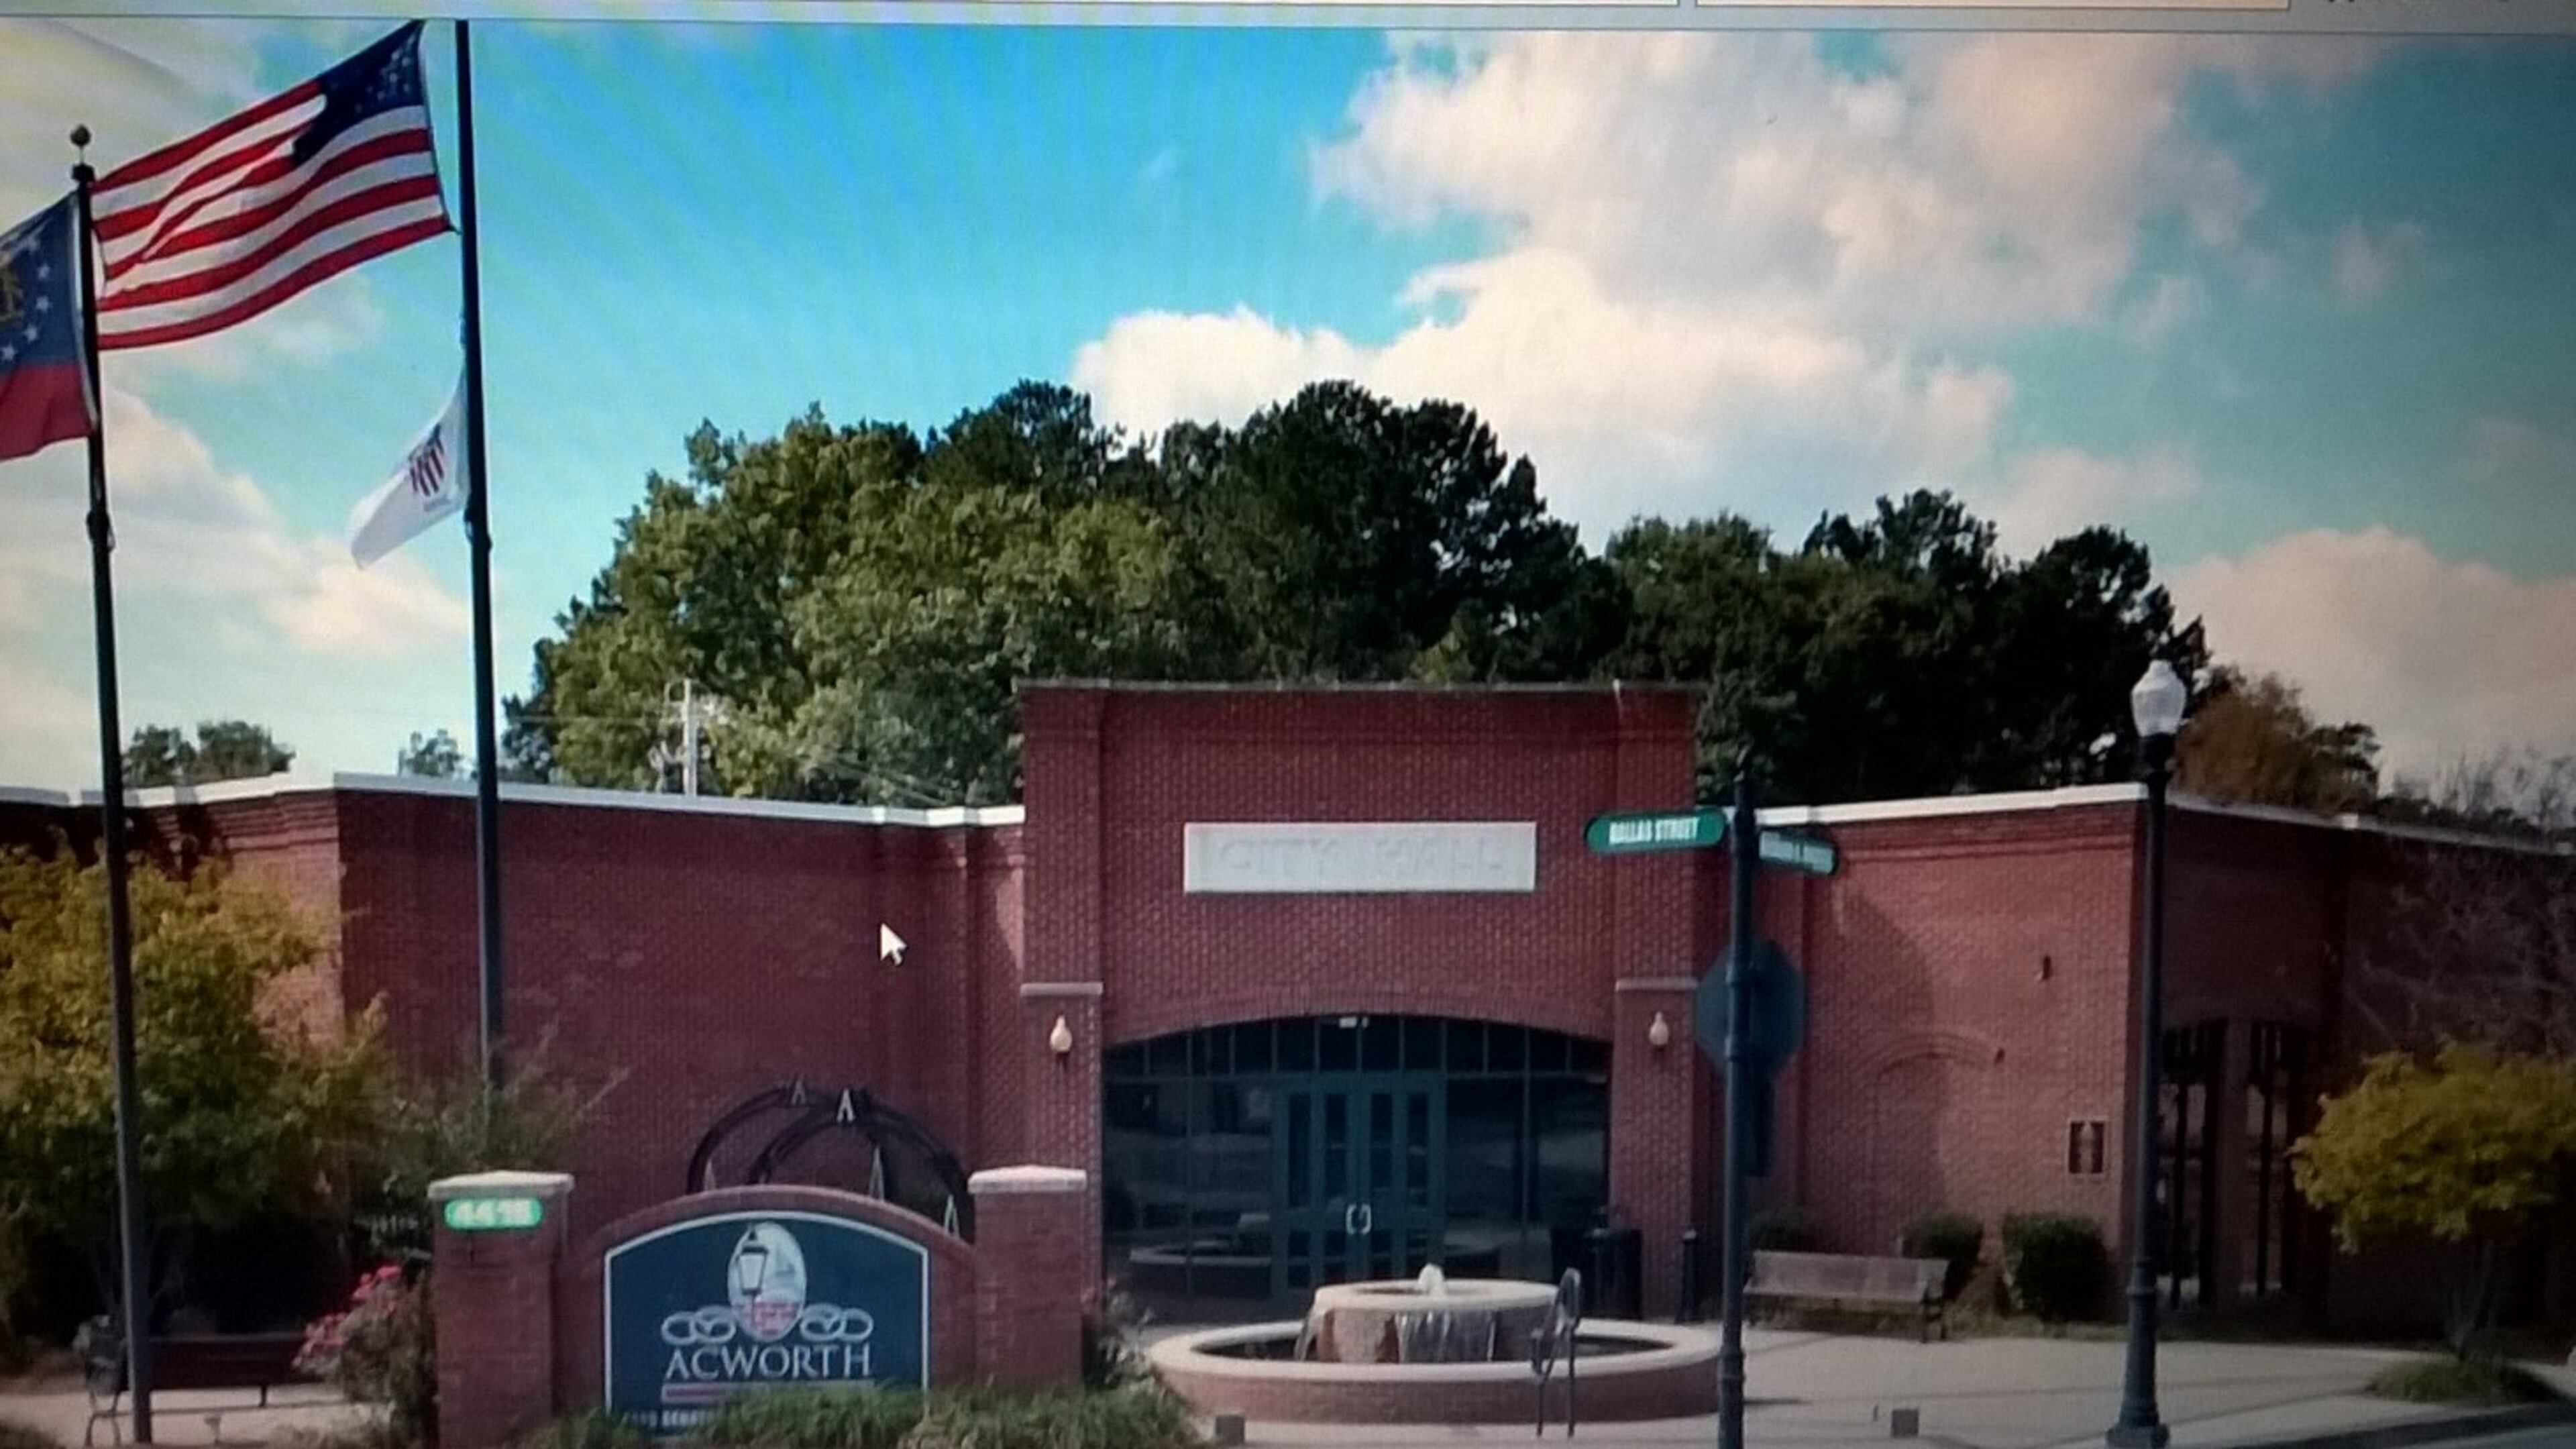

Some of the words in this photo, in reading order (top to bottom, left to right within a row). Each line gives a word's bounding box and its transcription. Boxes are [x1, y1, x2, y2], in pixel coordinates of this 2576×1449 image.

[1219, 837, 1341, 873] CITY
[1374, 837, 1504, 873] HALL
[665, 1344, 870, 1380] ACWORTH
